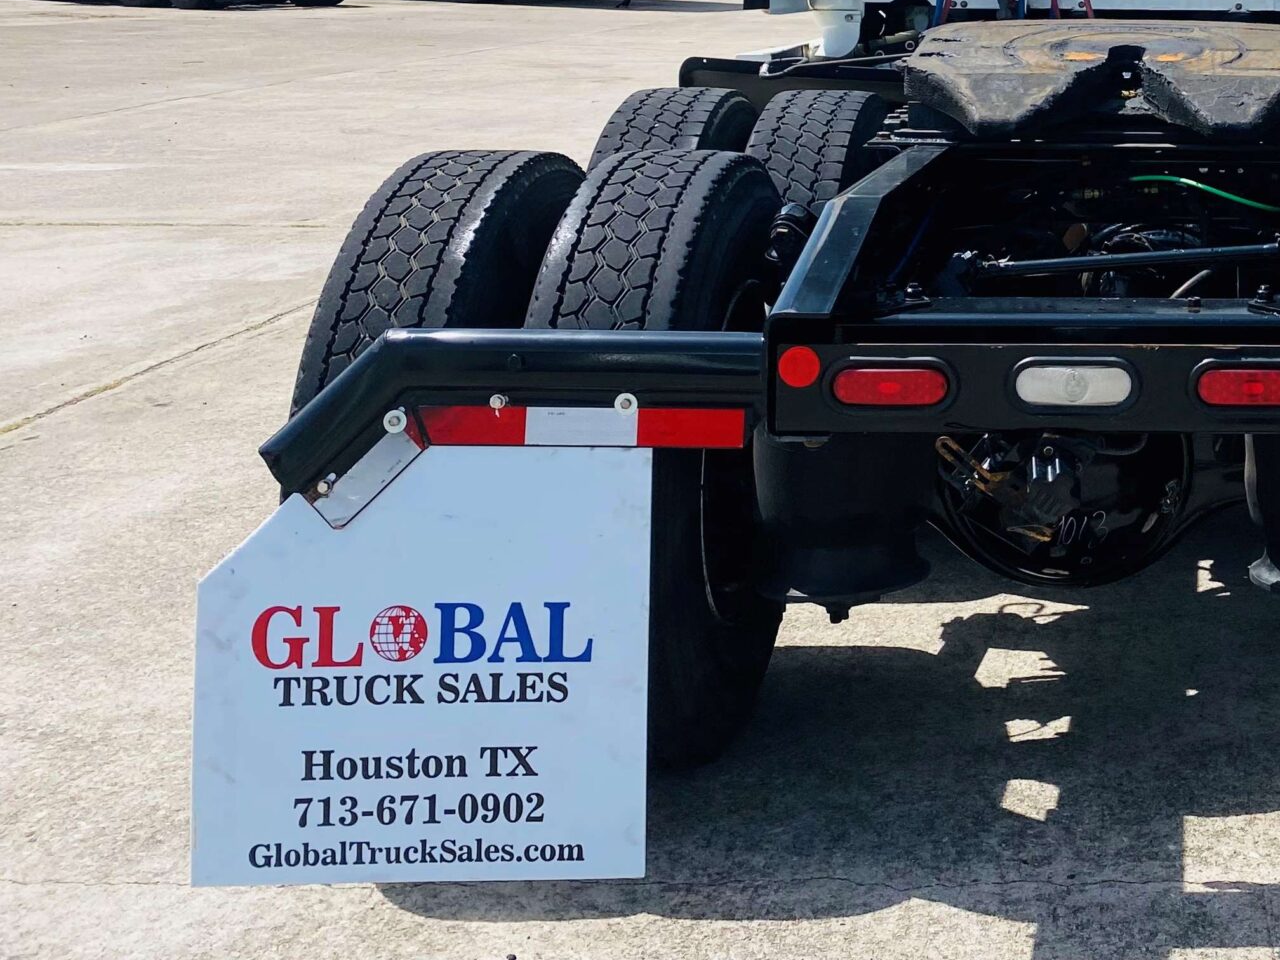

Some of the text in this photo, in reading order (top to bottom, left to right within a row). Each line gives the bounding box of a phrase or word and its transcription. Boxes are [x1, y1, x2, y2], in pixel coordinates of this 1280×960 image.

[274, 672, 569, 706] TRUCK SALES
[301, 746, 538, 780] Houston TX
[293, 793, 545, 827] 713-671-0902
[249, 838, 584, 868] GlobalTruckSales.com
